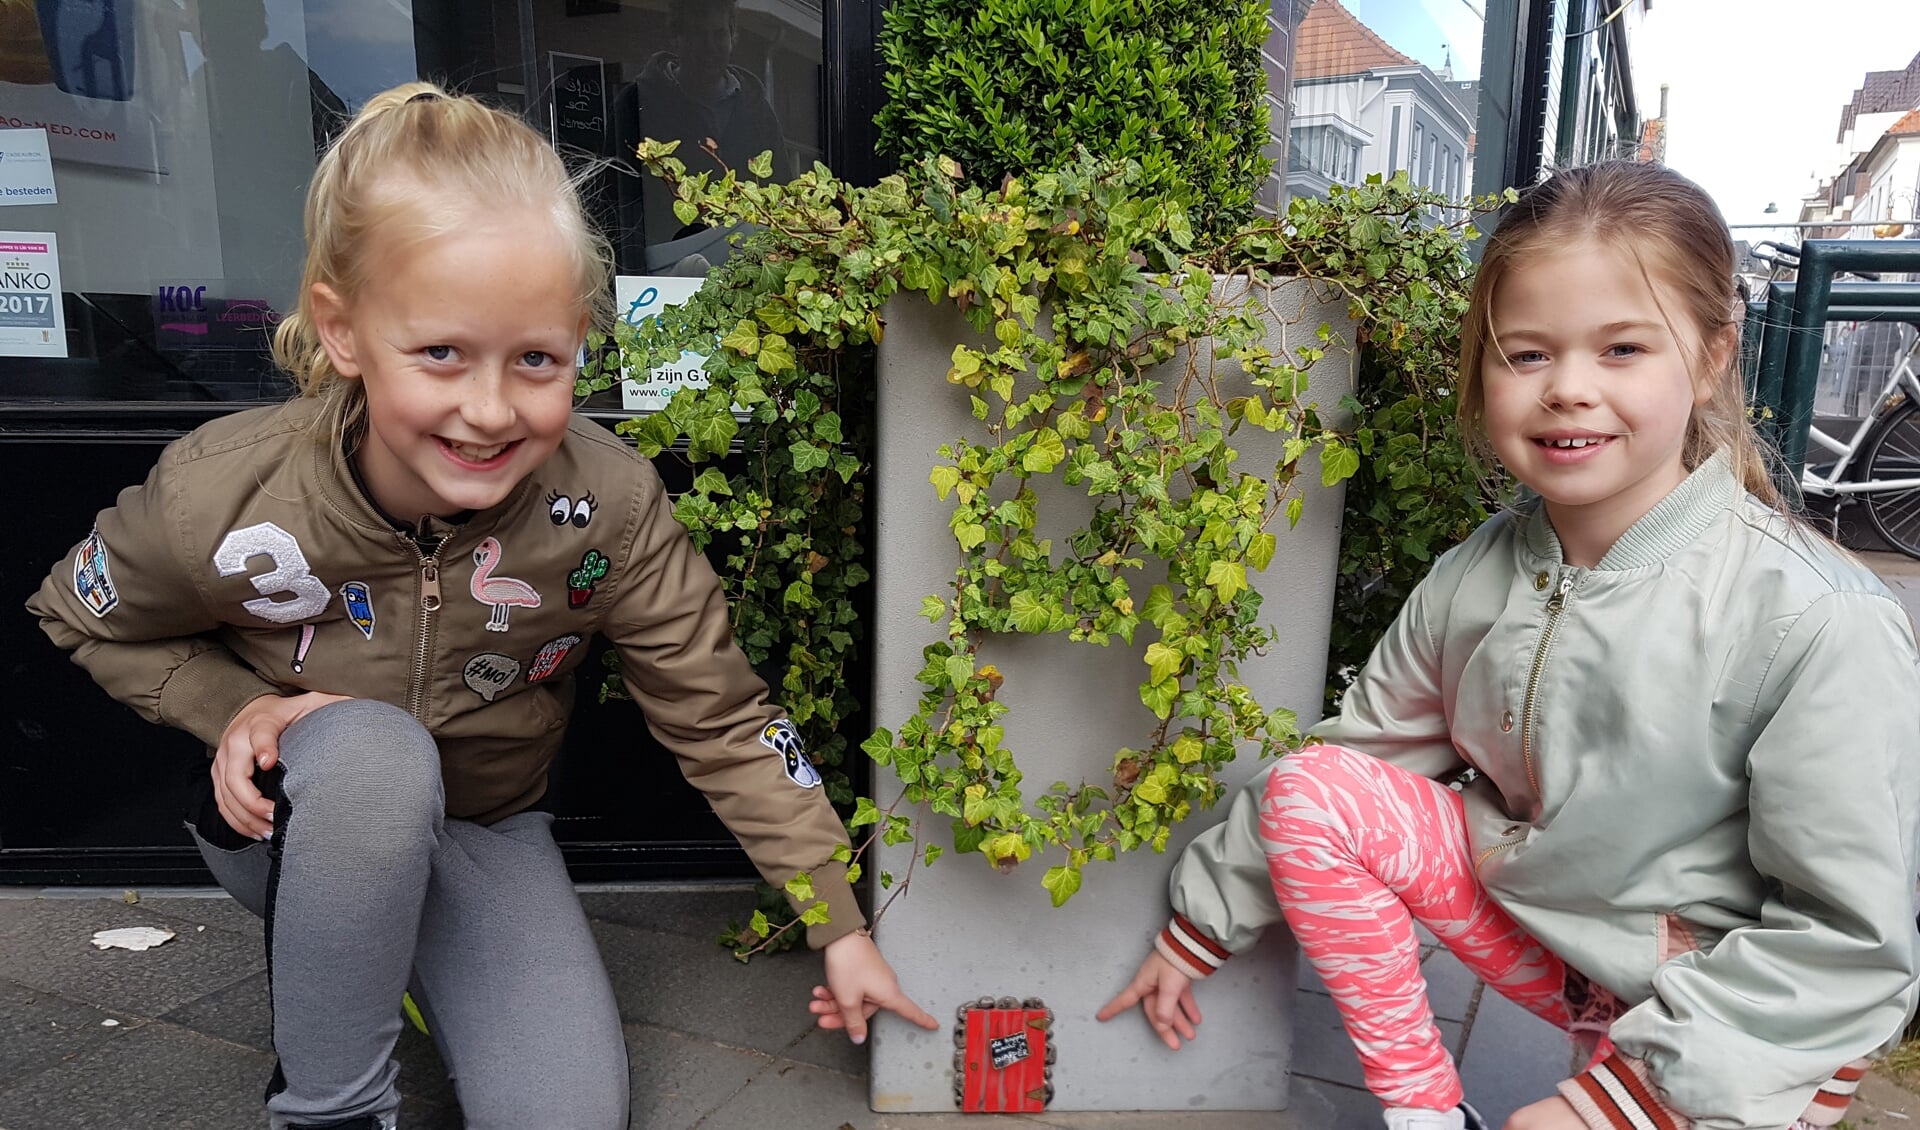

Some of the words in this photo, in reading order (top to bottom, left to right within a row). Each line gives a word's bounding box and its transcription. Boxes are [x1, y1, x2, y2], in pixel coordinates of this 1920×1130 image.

[6, 187, 52, 196] besteden
[0, 295, 49, 314] 2017
[159, 285, 207, 313] KOC
[656, 368, 682, 384] zijn
[213, 521, 332, 624] 3
